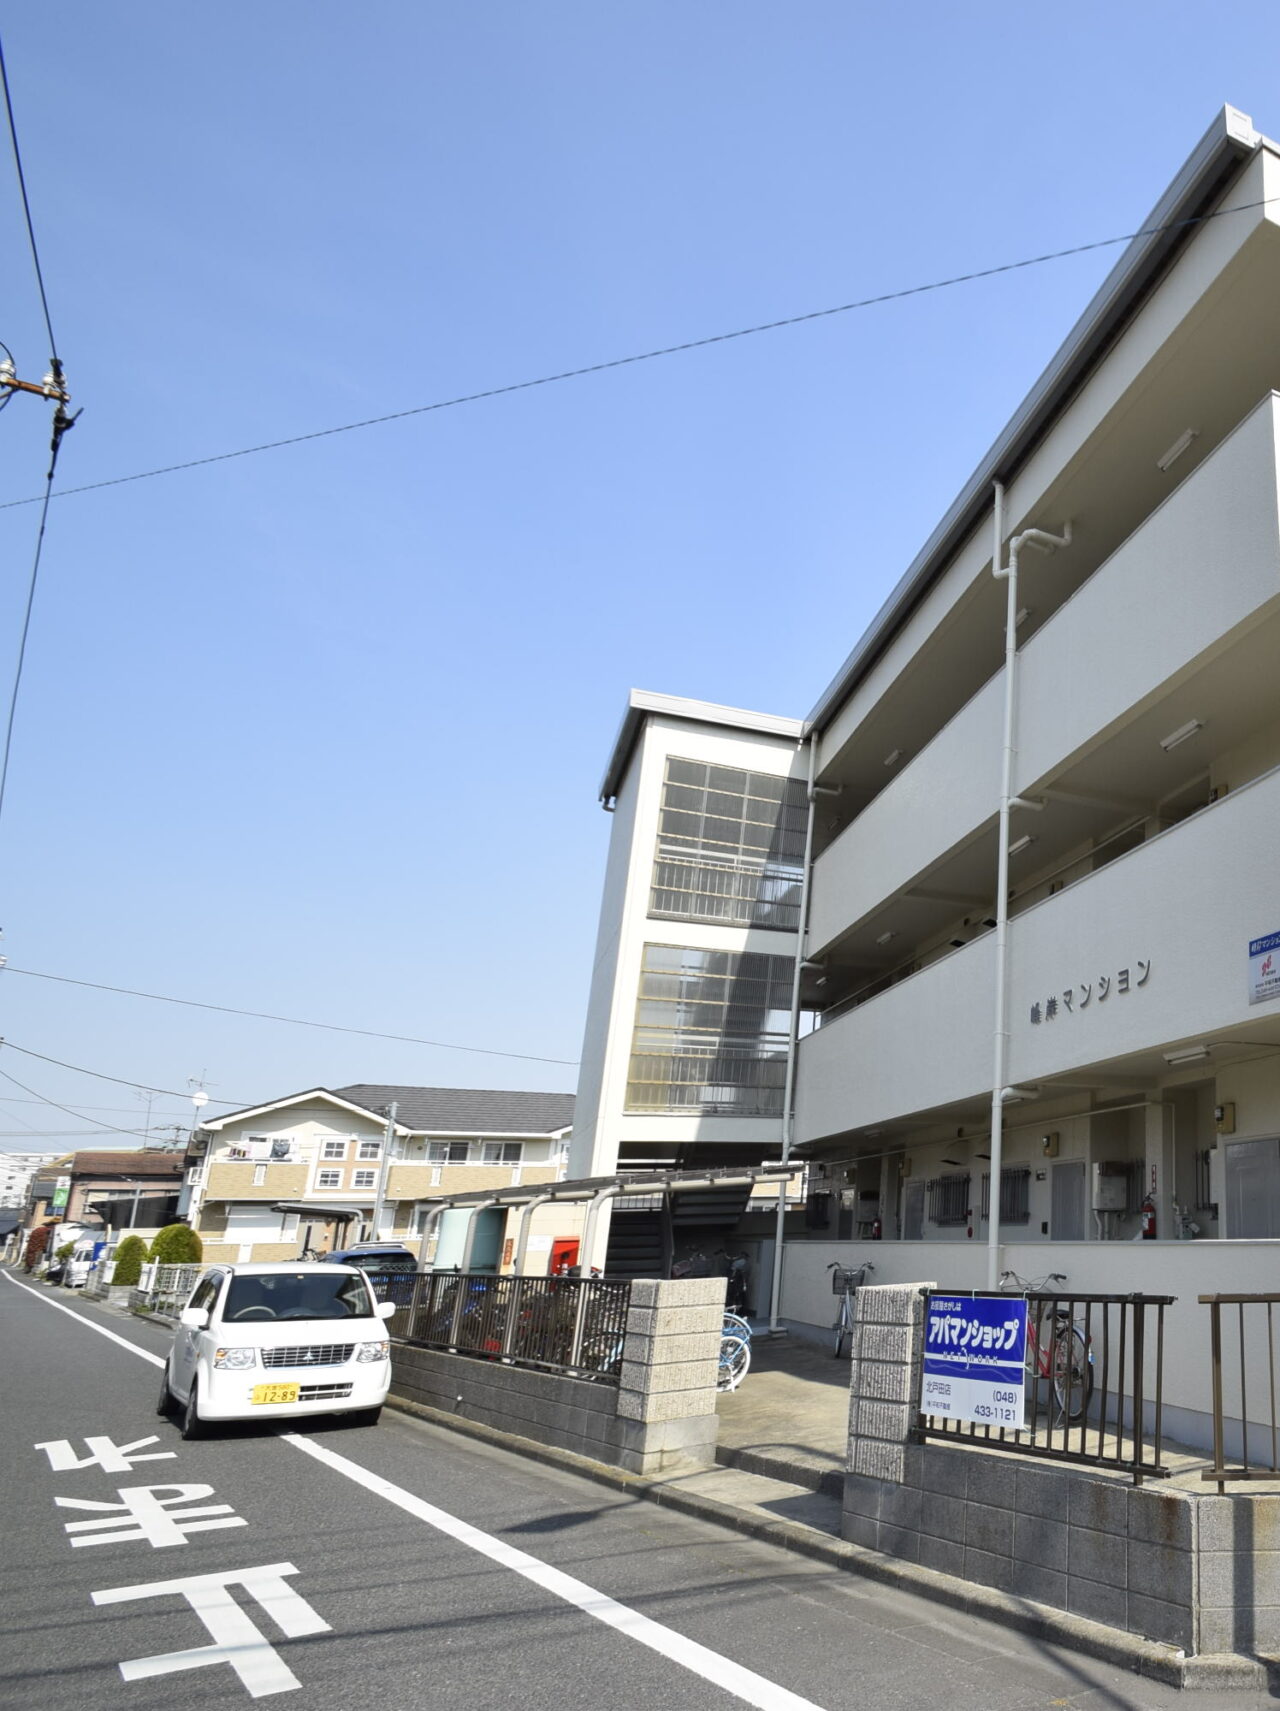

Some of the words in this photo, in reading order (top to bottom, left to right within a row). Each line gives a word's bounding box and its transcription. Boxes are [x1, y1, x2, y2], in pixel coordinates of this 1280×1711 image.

[928, 1314, 1020, 1350] アパマンショップ
[263, 1390, 296, 1402] 12-89
[992, 1389, 1018, 1405] (048)
[974, 1404, 1016, 1421] 433-1121
[33, 1434, 334, 1698] 止まれ
